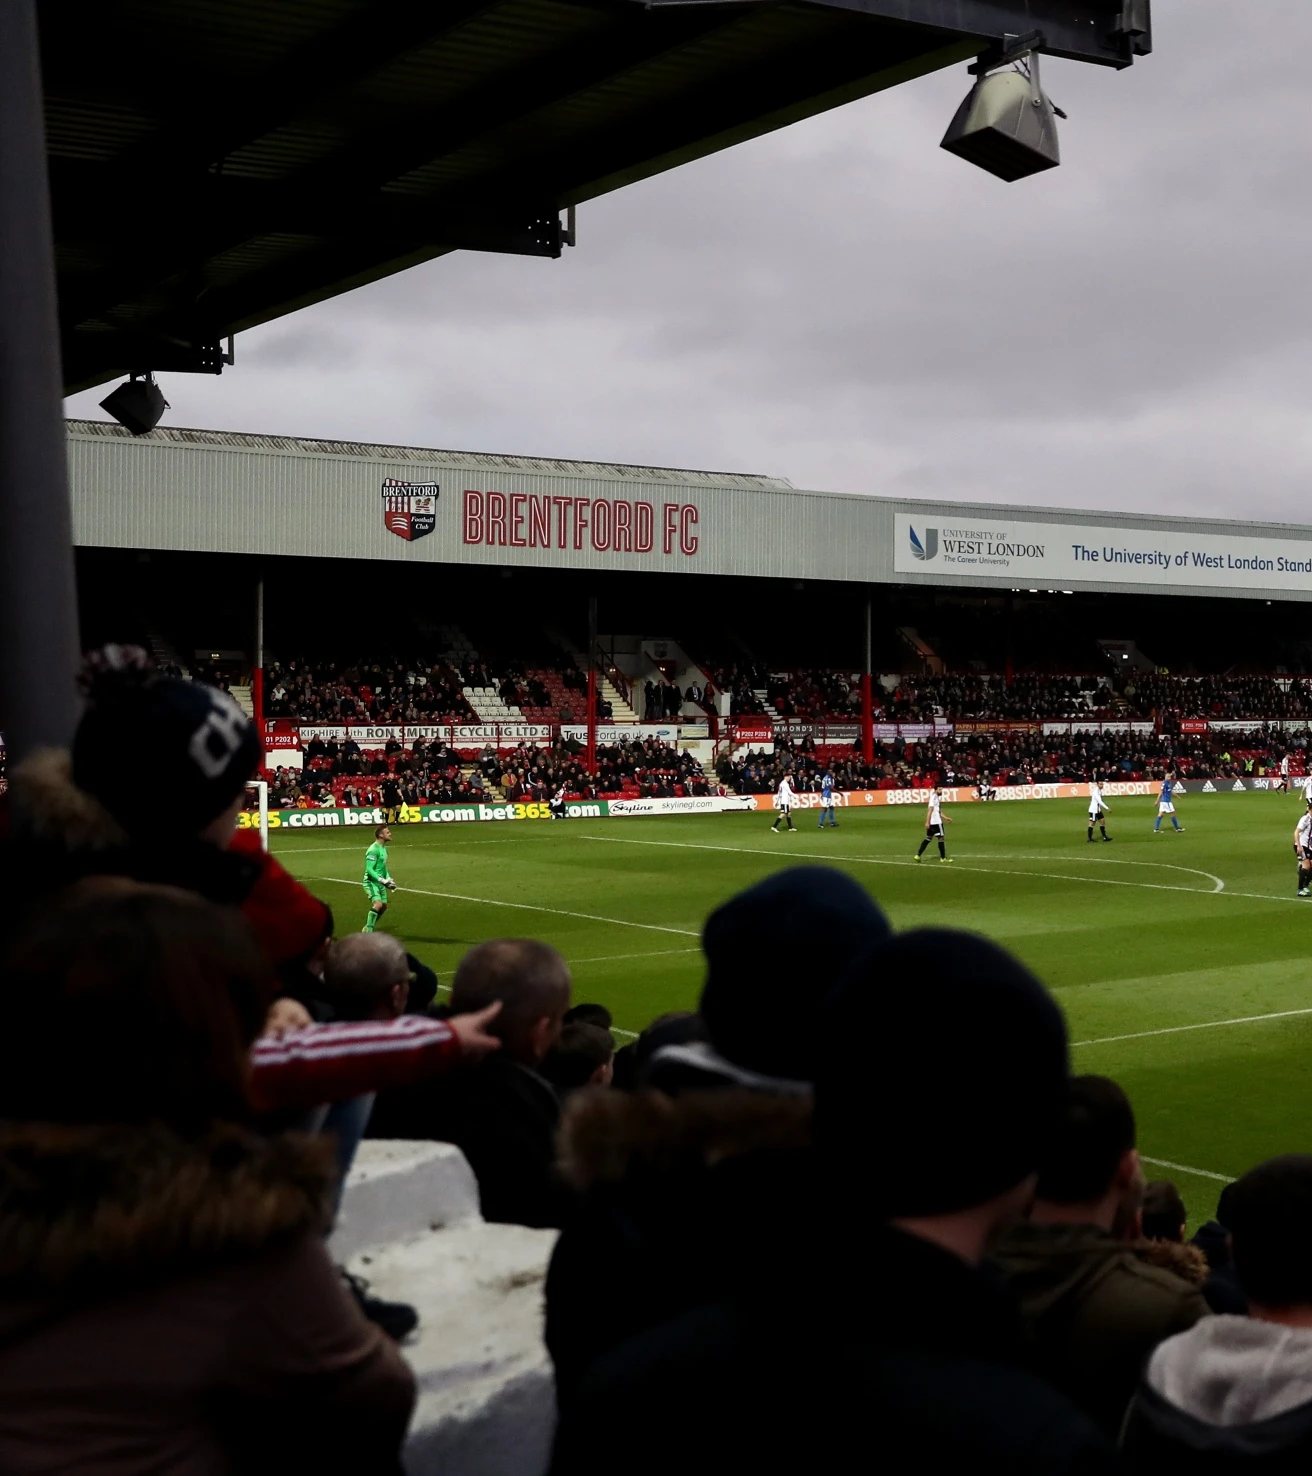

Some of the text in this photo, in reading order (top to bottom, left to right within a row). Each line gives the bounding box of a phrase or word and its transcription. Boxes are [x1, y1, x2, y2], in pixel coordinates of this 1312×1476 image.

[382, 484, 438, 500] BRENTFORD
[411, 514, 434, 525] Football
[463, 490, 698, 556] BRENTFORD FC
[415, 522, 429, 531] Club
[943, 529, 1007, 541] UNIVERSITY OF
[943, 539, 1045, 558] WEST LONDON
[944, 555, 1010, 567] The Career University
[1072, 545, 1312, 573] The University of West London Stand
[319, 728, 339, 737] HIRE
[367, 728, 394, 738] RON
[399, 727, 439, 738] SMITH
[444, 727, 512, 738] RECYCLING
[517, 727, 537, 737] LTD
[564, 730, 644, 740] TrusFord.co.uk
[1254, 777, 1269, 790] sky
[479, 803, 600, 820] bet365om
[662, 800, 713, 812] skylinegl.com
